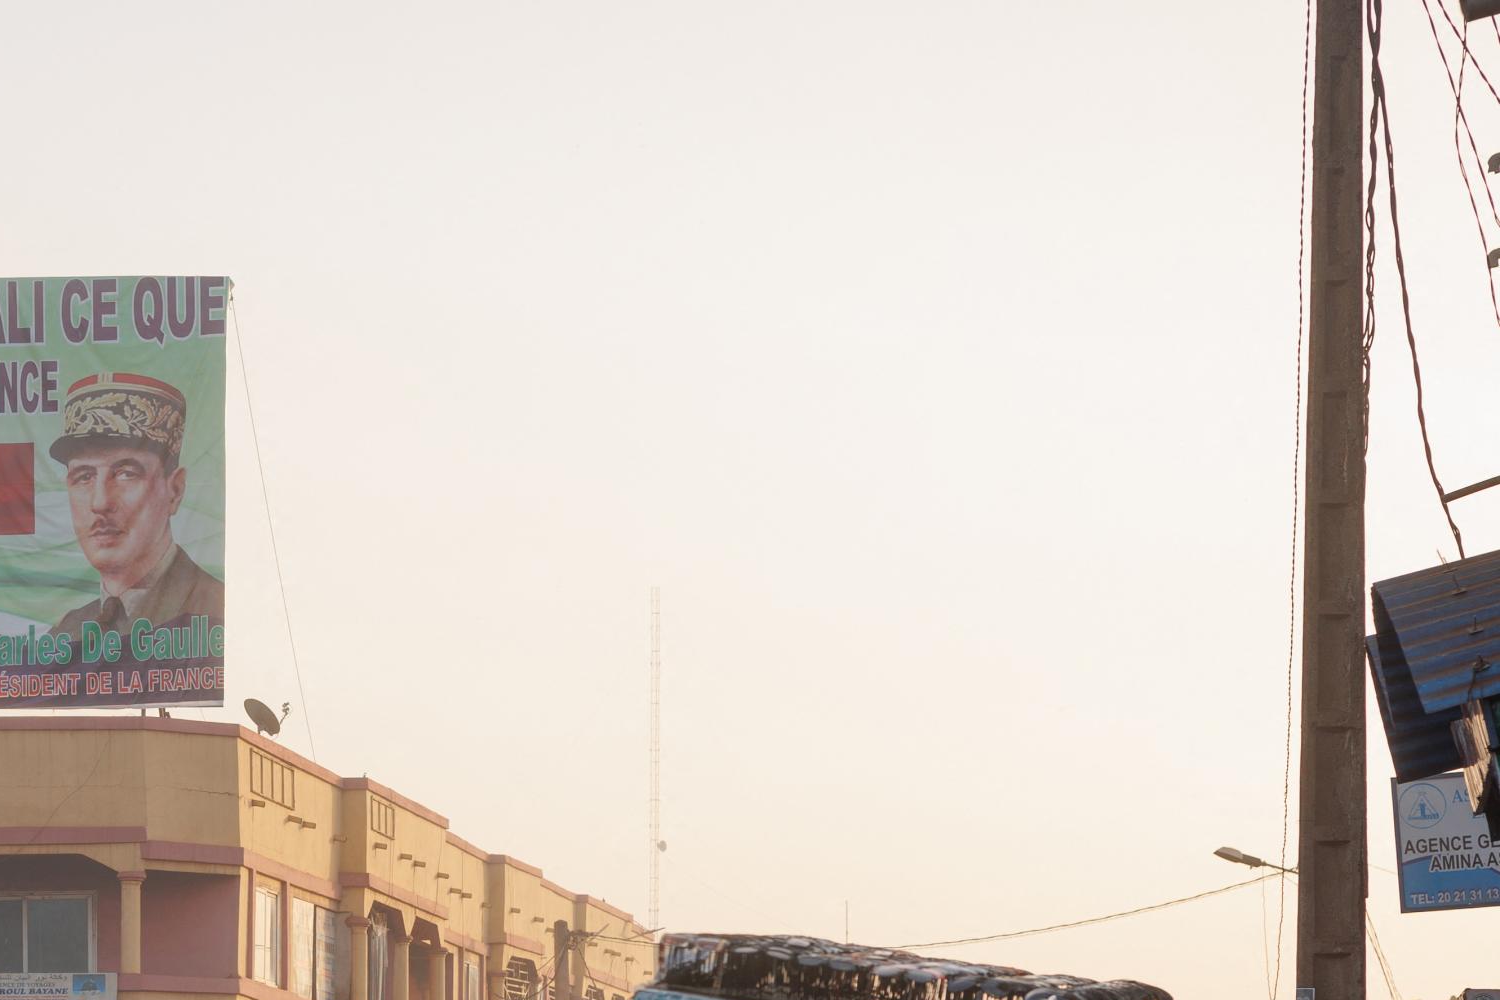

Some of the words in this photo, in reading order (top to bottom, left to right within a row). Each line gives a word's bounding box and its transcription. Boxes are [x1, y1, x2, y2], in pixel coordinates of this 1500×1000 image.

[60, 278, 118, 344] CE
[132, 275, 226, 347] QUE
[81, 620, 122, 664] De
[130, 614, 225, 662] Gaulle
[86, 671, 113, 695] DE
[117, 671, 143, 694] LA
[148, 666, 225, 692] FRANCE
[1404, 835, 1473, 855] AGENCE
[1429, 853, 1484, 872] AMINA
[1411, 893, 1435, 905] TEL:
[1437, 892, 1452, 903] 20
[1453, 890, 1467, 902] 21
[1470, 889, 1482, 901] 31
[28, 987, 69, 996] BAYANE
